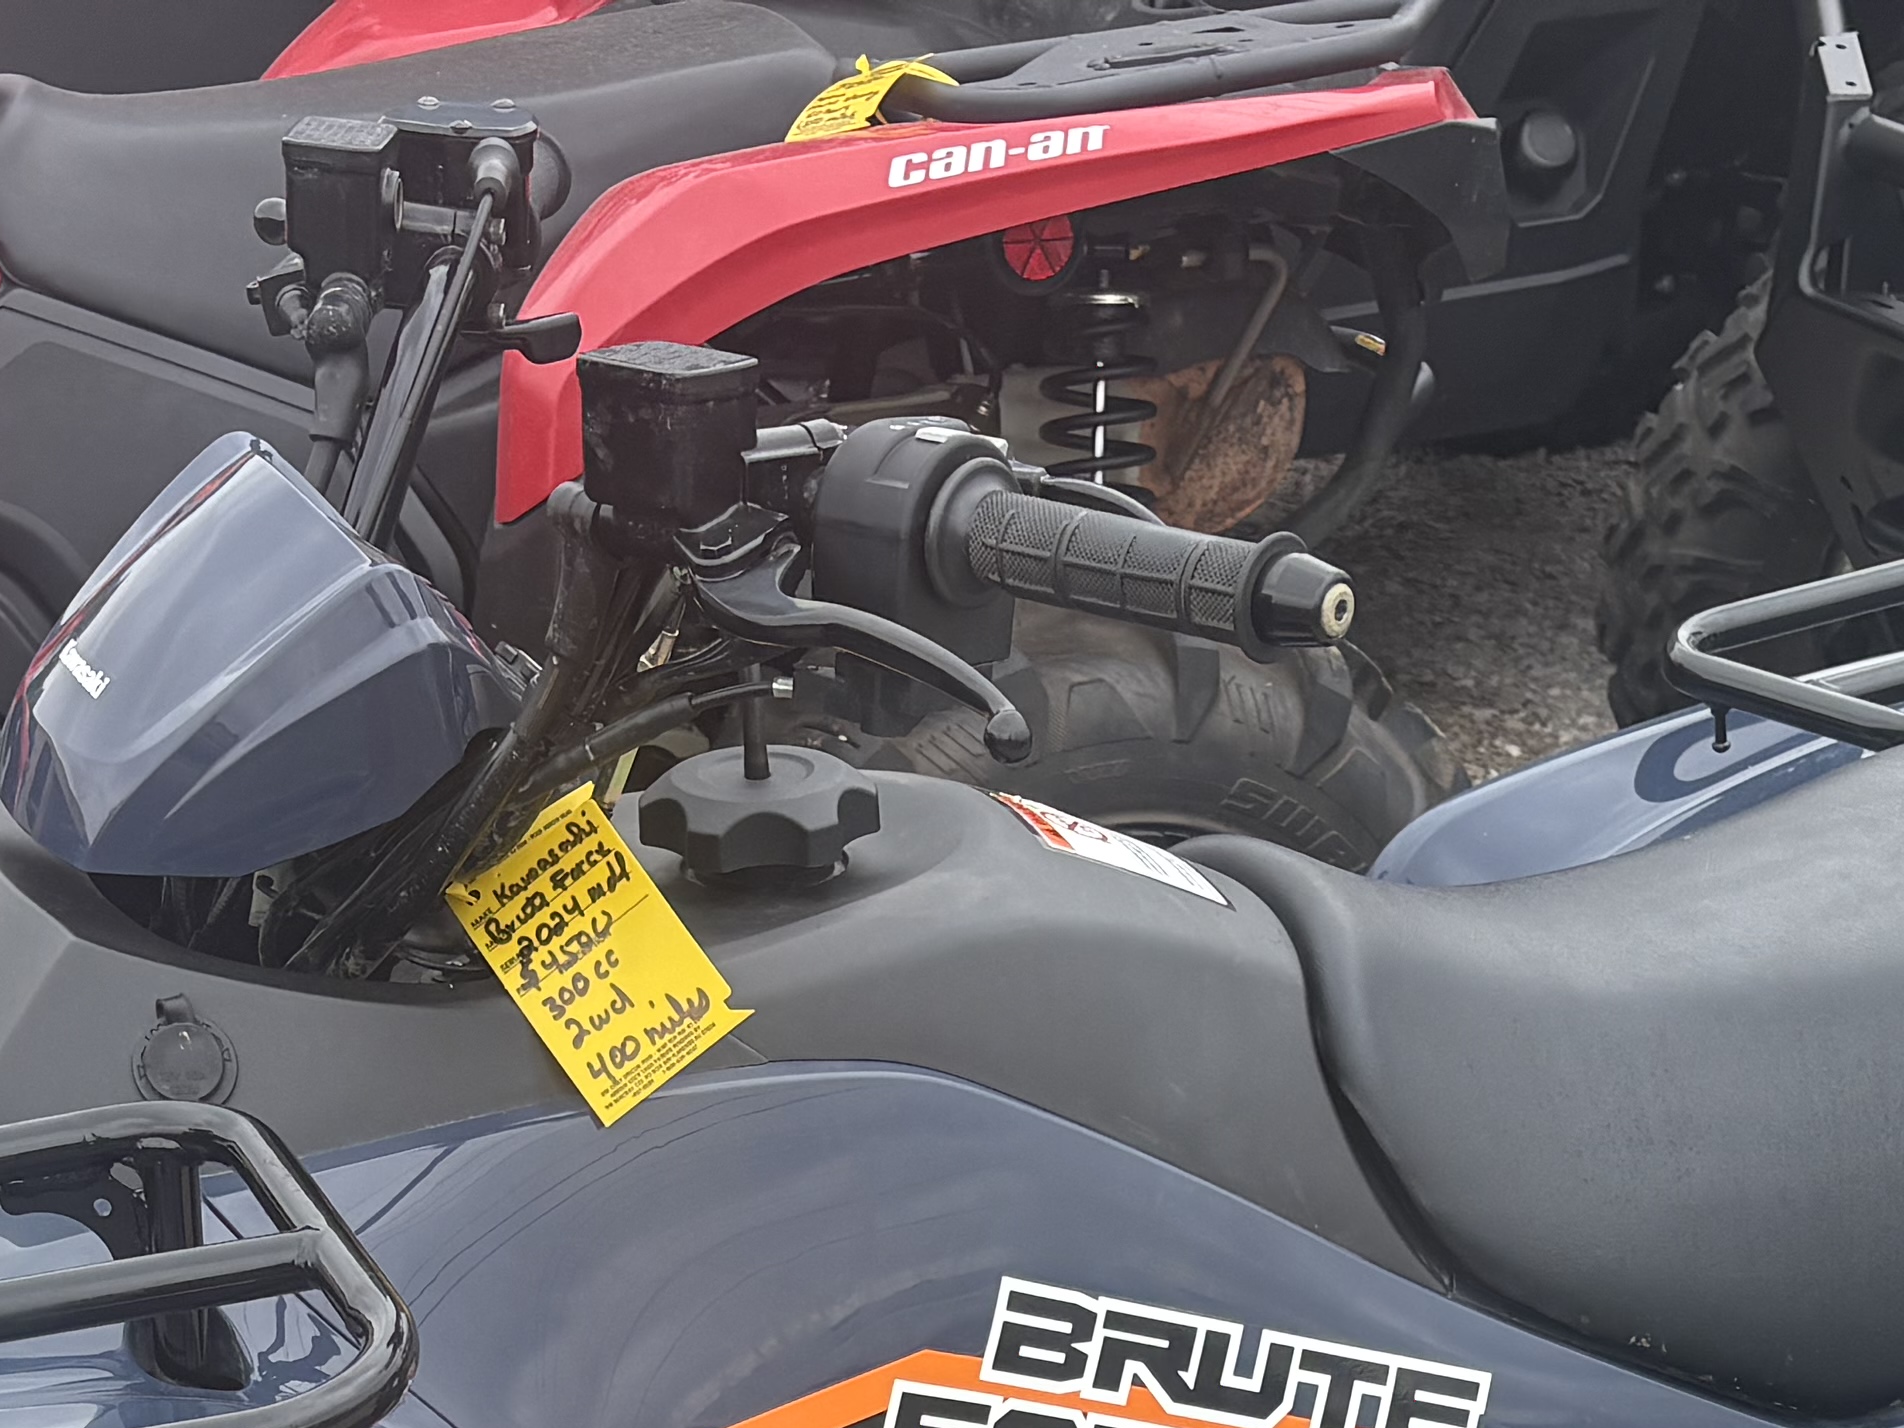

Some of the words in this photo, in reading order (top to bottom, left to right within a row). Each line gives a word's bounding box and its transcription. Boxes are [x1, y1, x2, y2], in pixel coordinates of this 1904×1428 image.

[517, 897, 585, 958] 2024
[541, 973, 590, 1022] 300
[586, 1034, 642, 1087] 400
